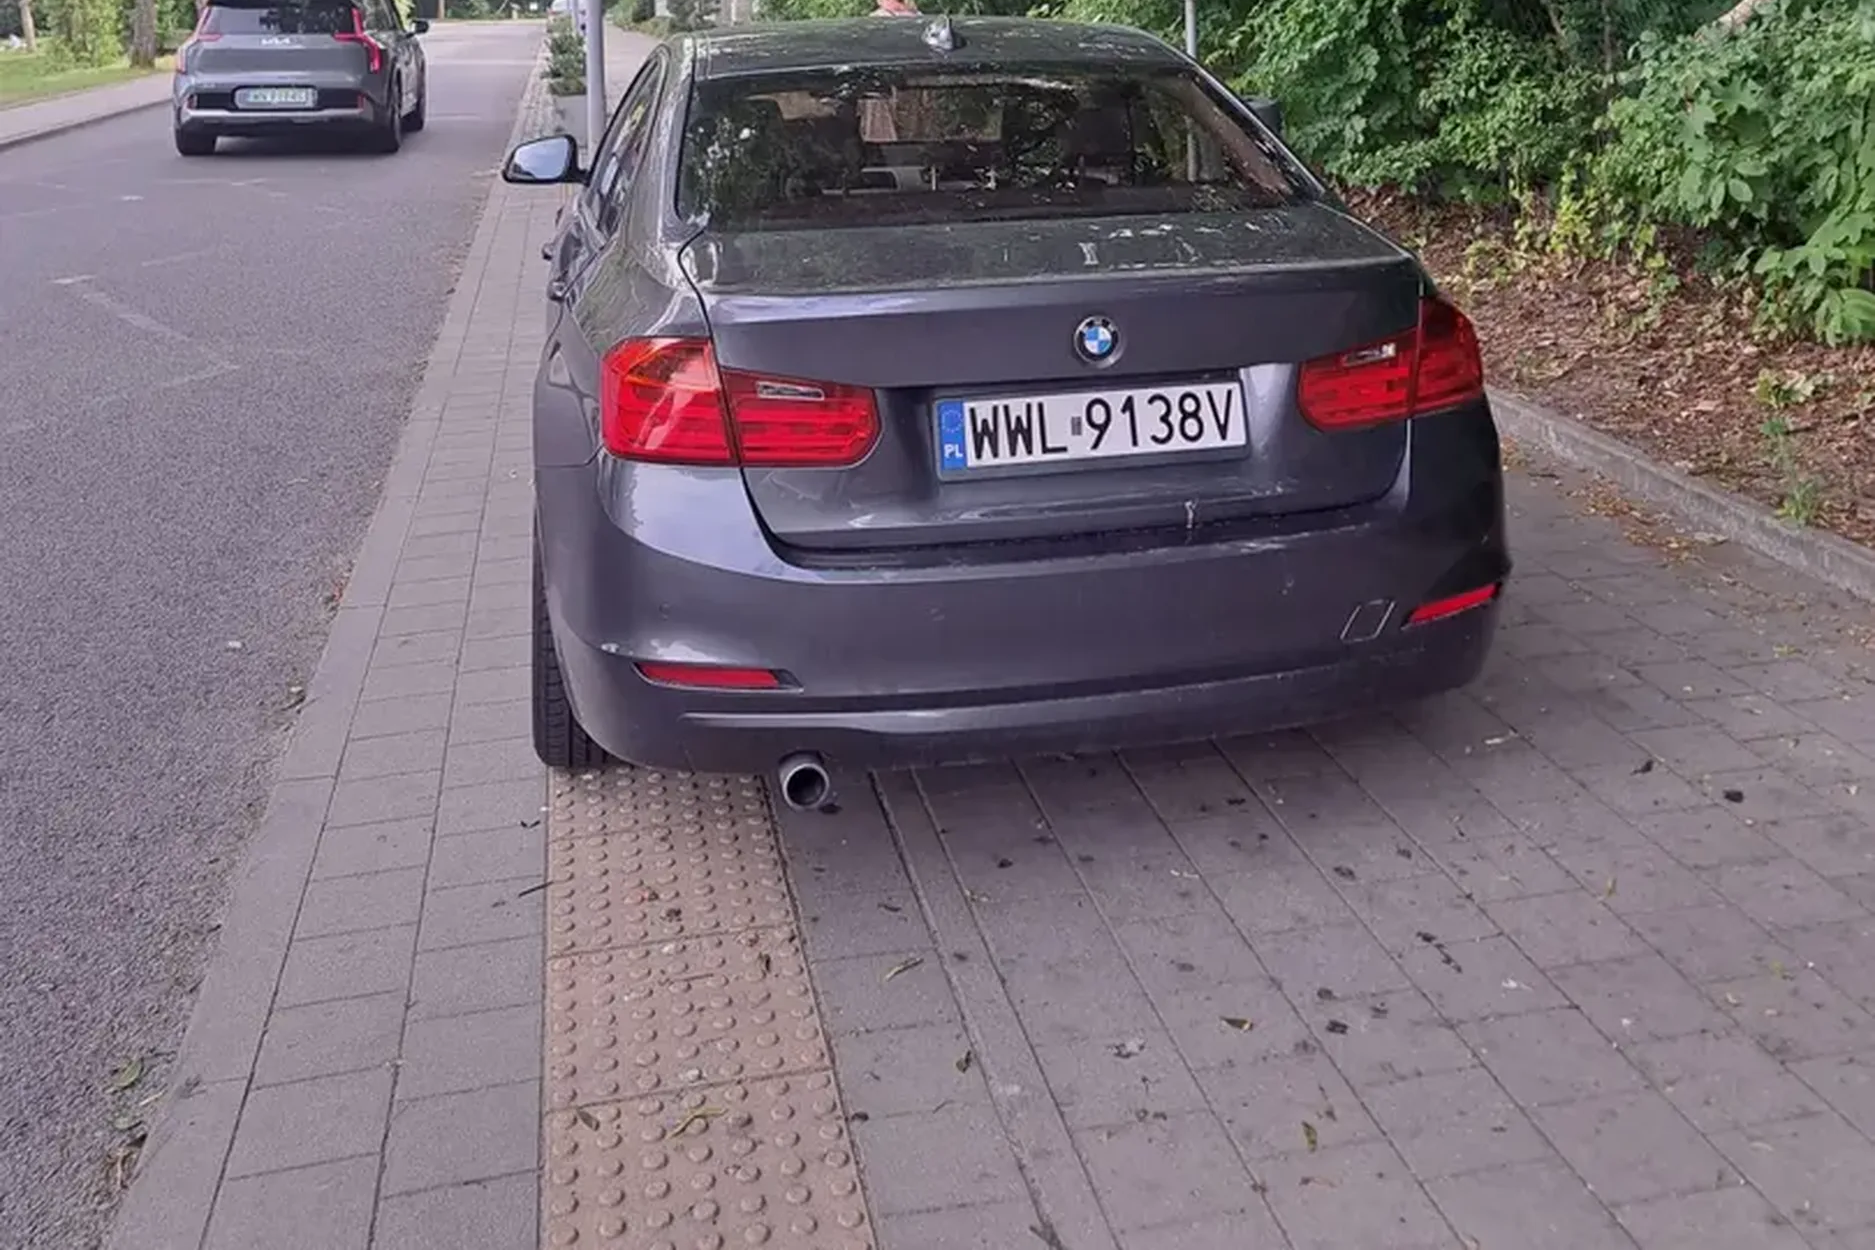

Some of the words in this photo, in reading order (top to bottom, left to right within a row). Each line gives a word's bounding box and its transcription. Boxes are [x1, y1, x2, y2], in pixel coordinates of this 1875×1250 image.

[969, 403, 1068, 460] WWL
[1086, 389, 1233, 450] 9138V
[944, 443, 964, 460] PL
